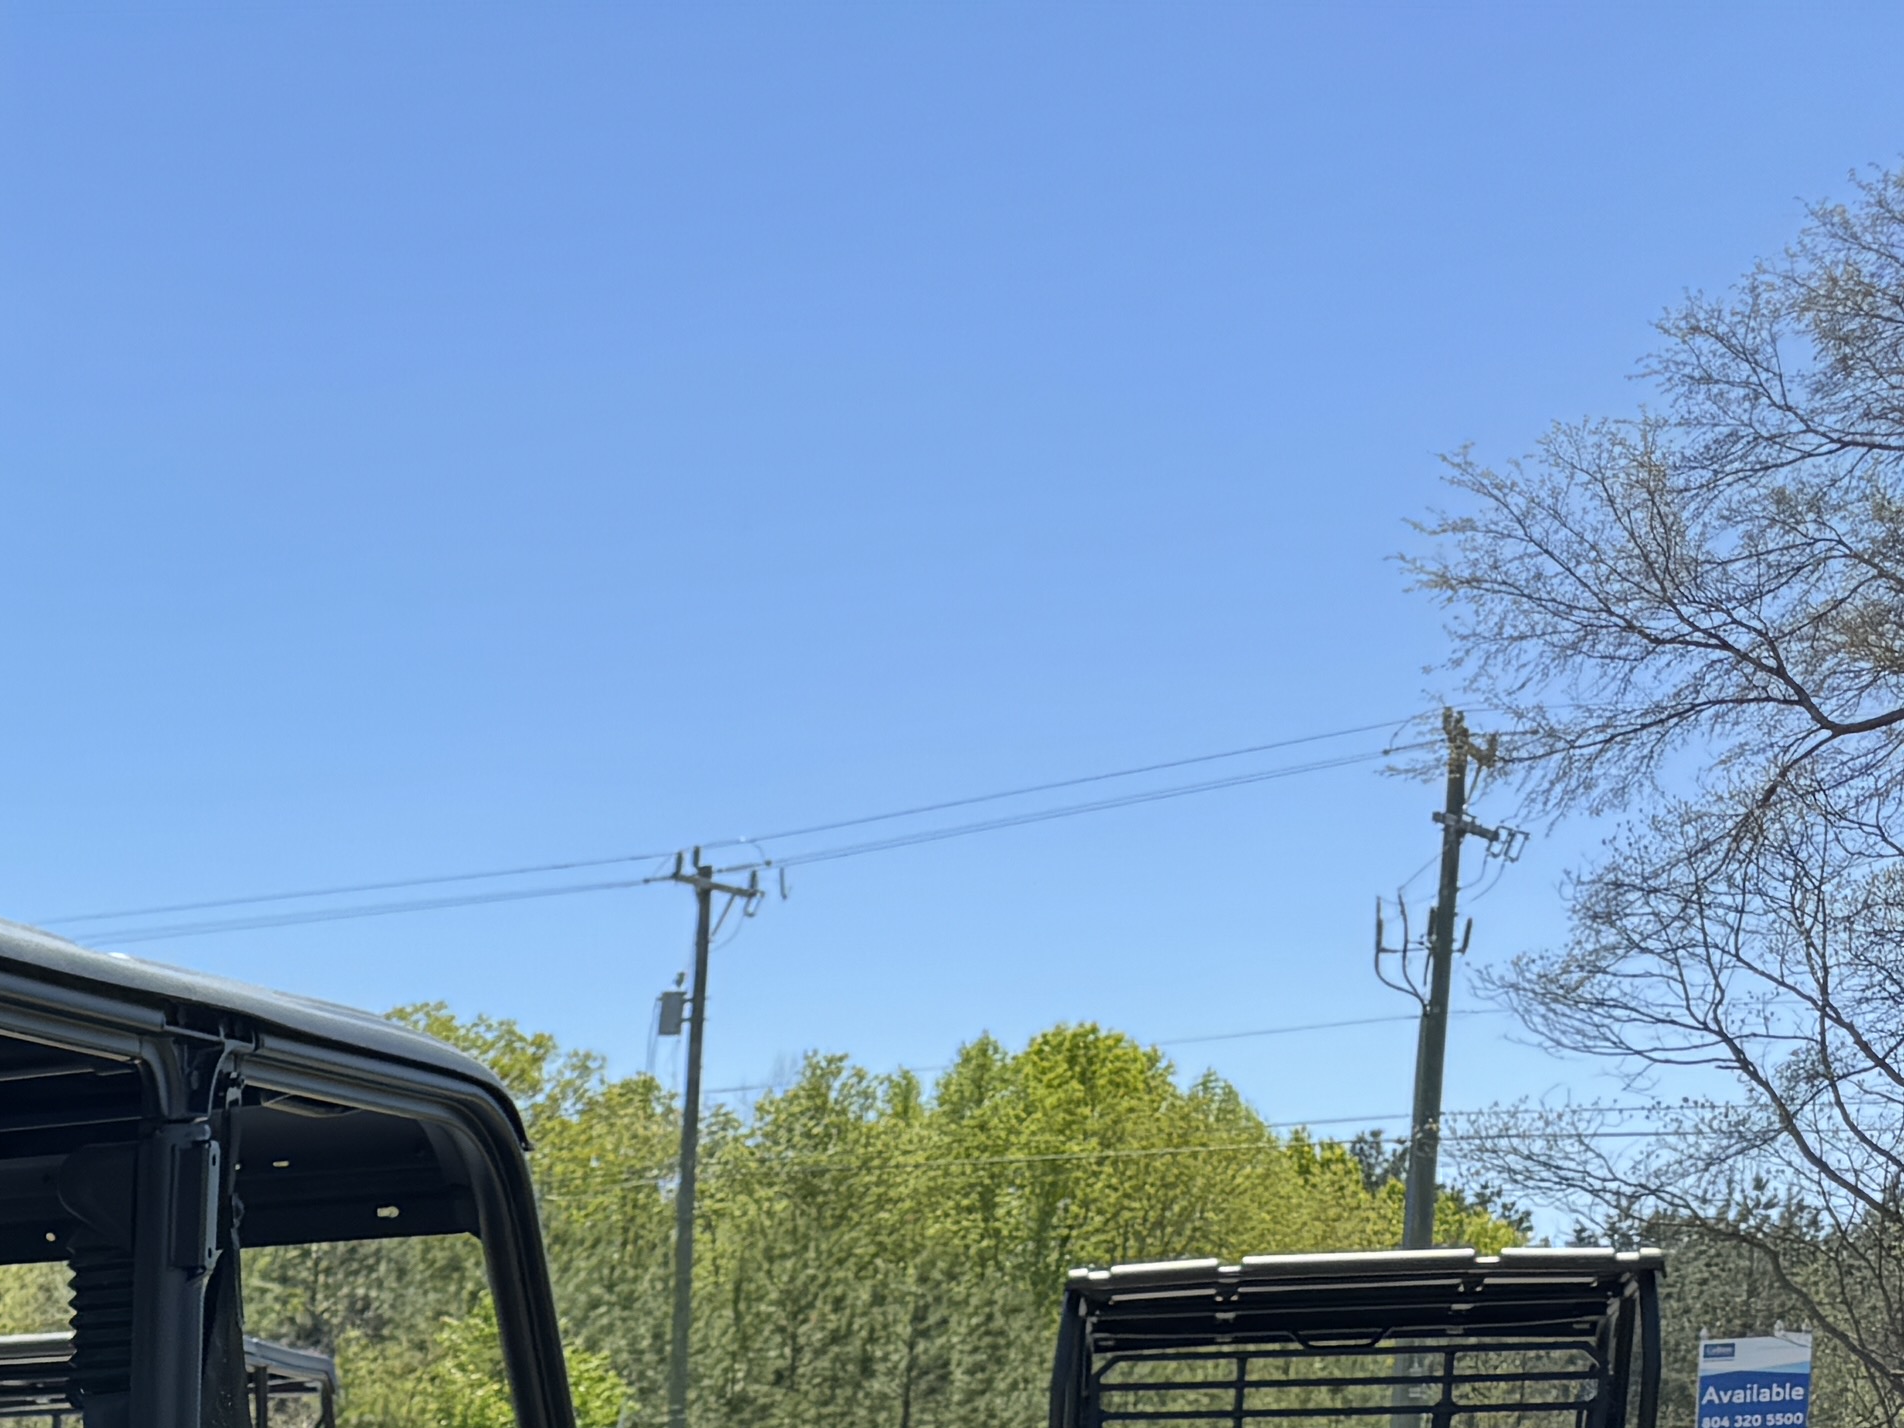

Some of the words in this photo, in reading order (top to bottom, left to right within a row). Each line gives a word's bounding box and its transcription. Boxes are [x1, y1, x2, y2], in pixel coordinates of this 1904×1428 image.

[1700, 1382, 1805, 1406] Available
[1733, 1414, 1762, 1428] 320
[1765, 1412, 1804, 1427] 5500
